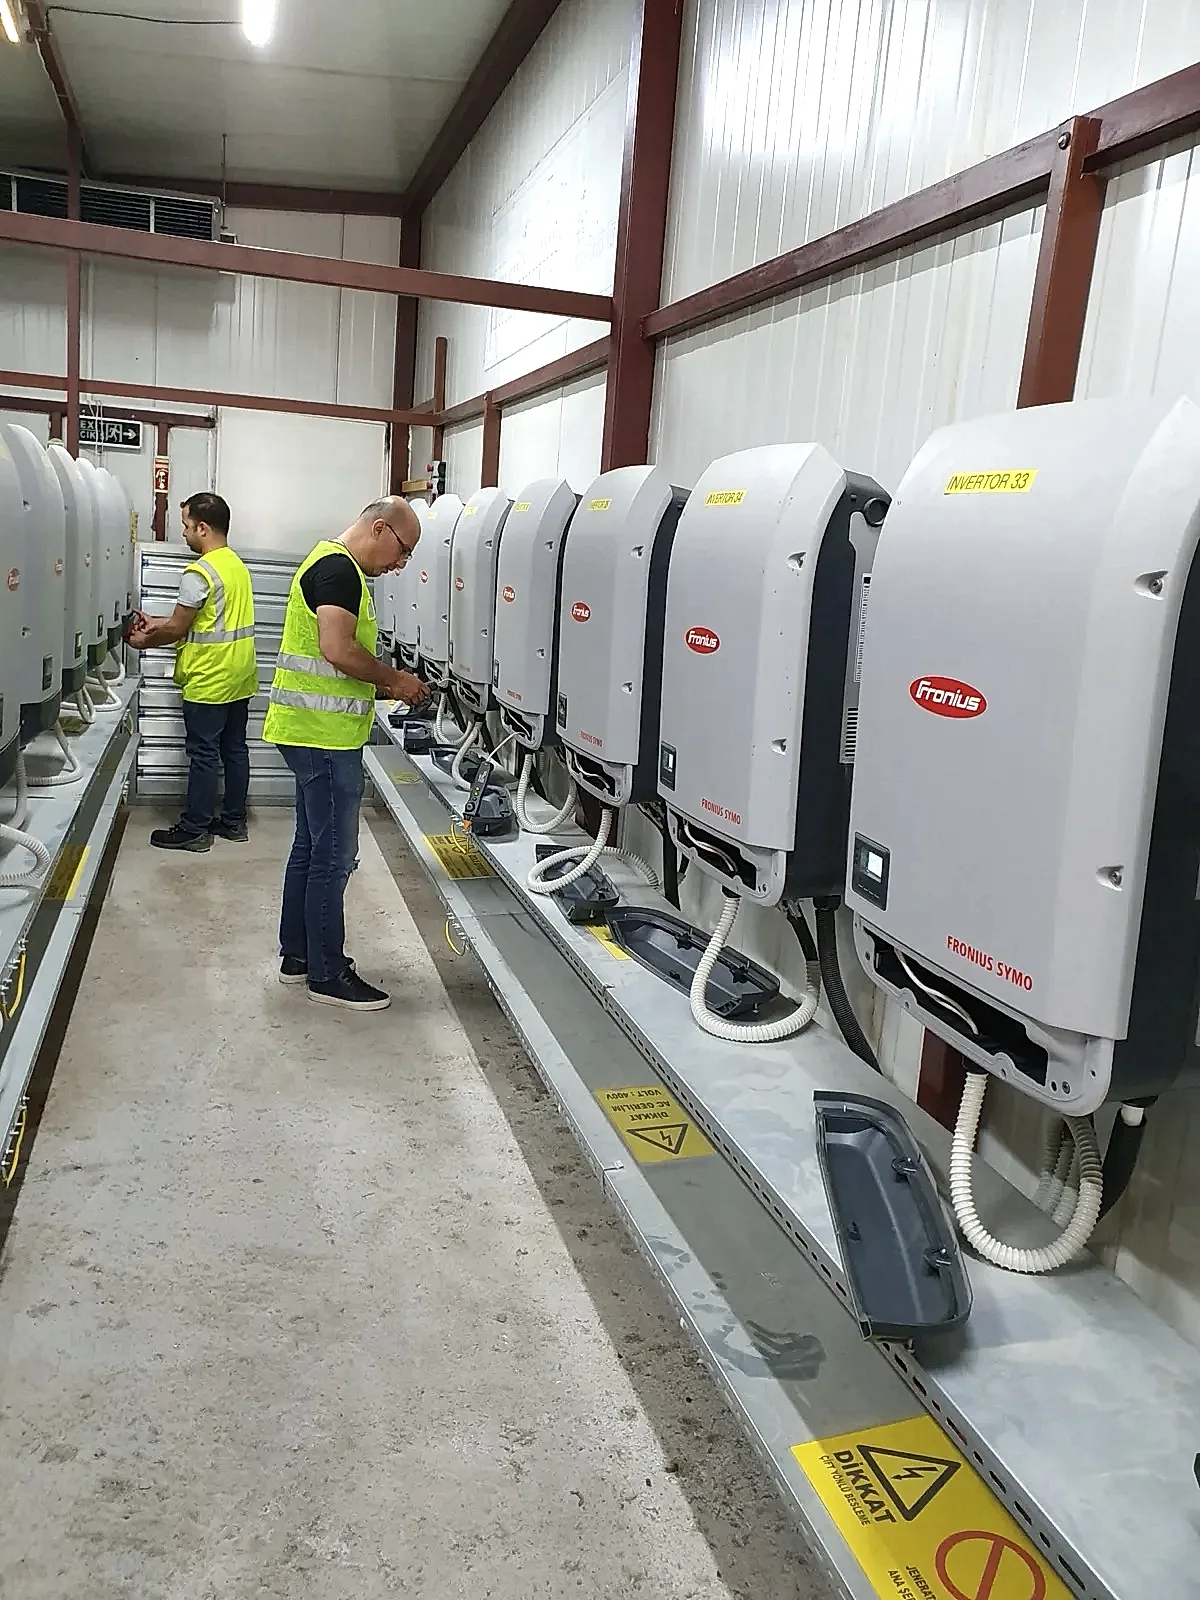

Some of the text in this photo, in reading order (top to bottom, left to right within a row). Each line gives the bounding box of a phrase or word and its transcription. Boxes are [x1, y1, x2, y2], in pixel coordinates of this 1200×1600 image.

[80, 420, 105, 431] EXT
[947, 473, 1030, 490] INVERTOR 33
[687, 630, 718, 649] Fronius
[915, 680, 981, 712] Fronius
[724, 808, 741, 825] SYMO
[947, 935, 1033, 991] FRONIUS SYMO
[636, 1089, 662, 1098] VOLT
[656, 1100, 671, 1108] AC
[833, 1450, 898, 1523] DİKKAT
[844, 1493, 871, 1526] BESLEME
[888, 1569, 906, 1588] ANA
